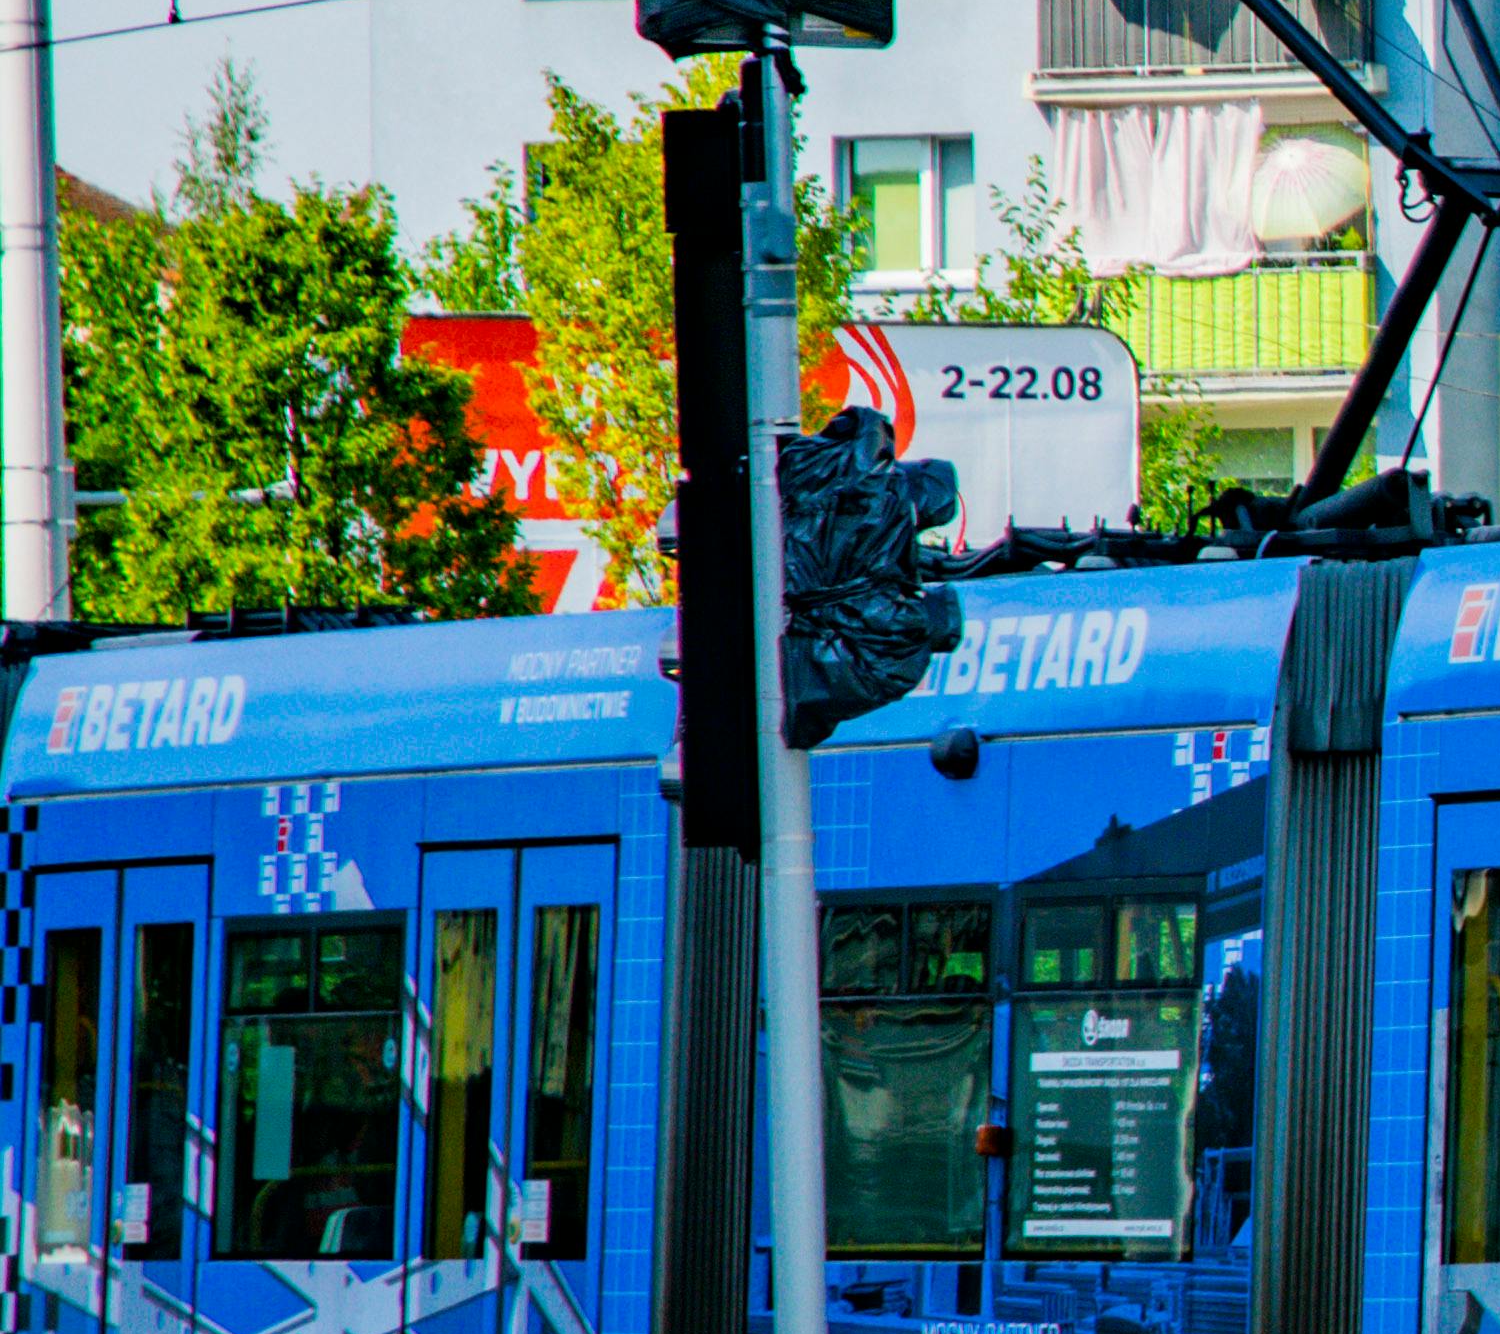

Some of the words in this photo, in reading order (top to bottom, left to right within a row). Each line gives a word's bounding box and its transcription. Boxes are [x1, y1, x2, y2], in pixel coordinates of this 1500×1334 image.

[941, 365, 1102, 401] 2-22.08
[944, 607, 1147, 696] BETARD
[79, 675, 246, 752] BETARD
